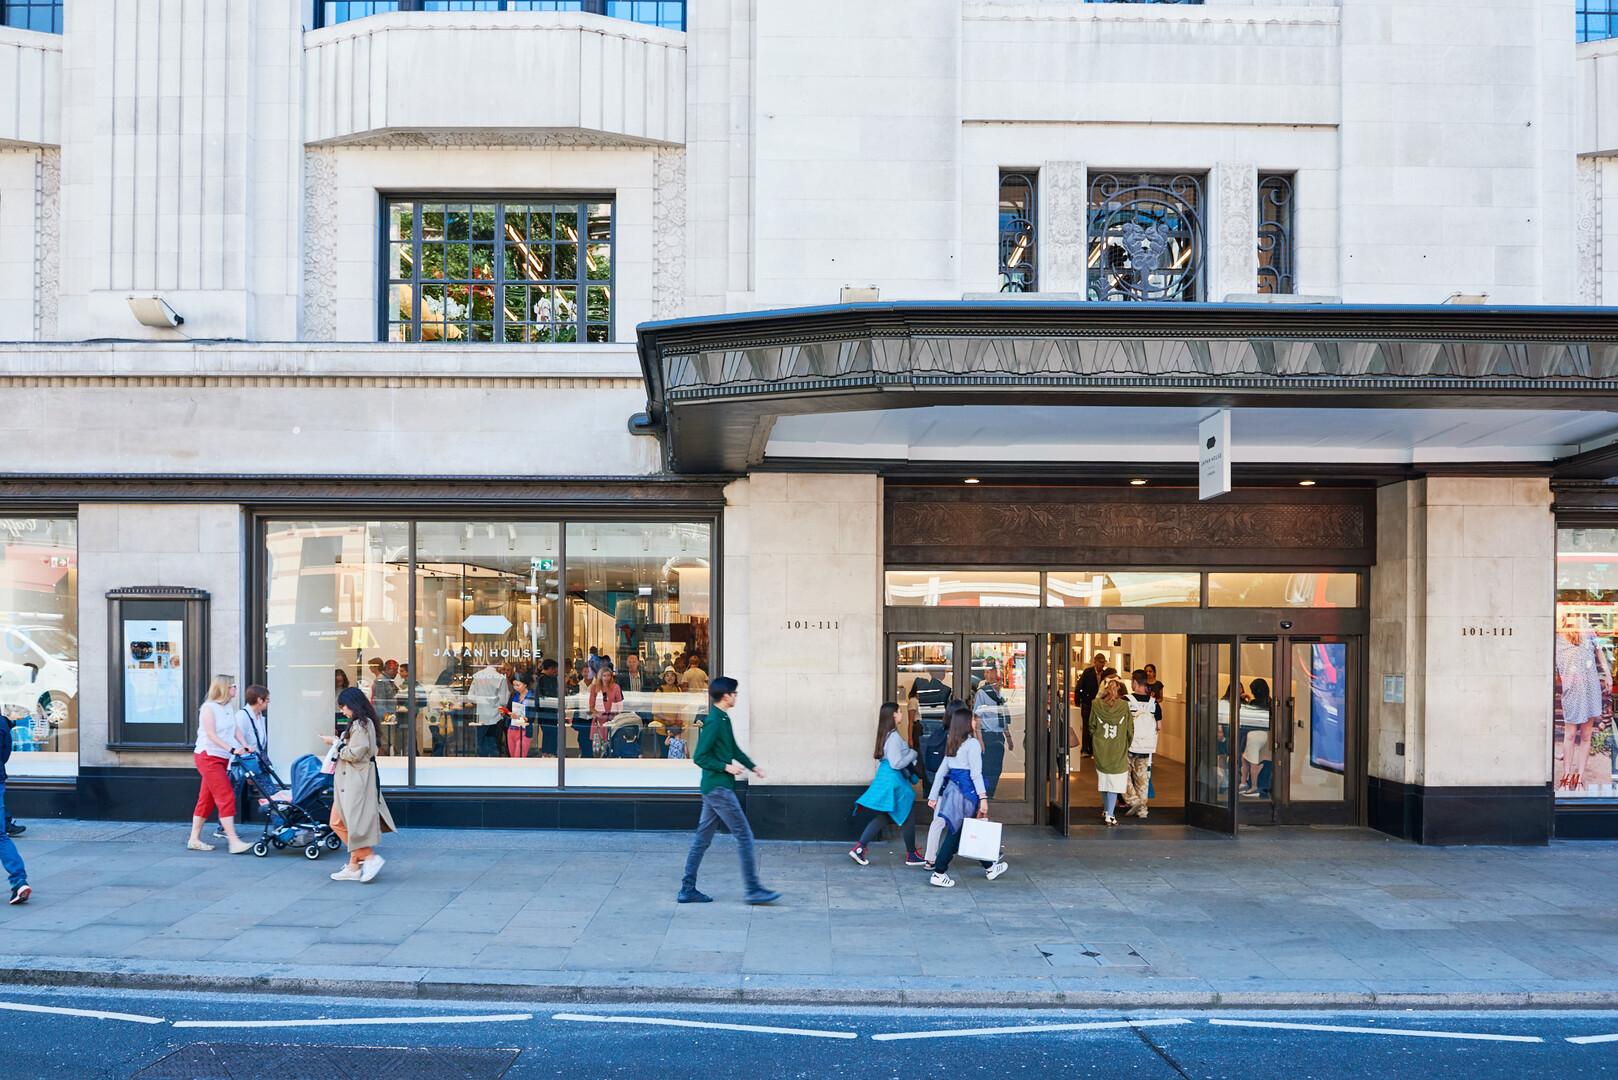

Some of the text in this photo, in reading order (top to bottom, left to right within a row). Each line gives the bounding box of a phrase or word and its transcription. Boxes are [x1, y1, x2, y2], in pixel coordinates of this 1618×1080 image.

[787, 621, 838, 629] 101-111
[1462, 628, 1512, 636] 101-111
[433, 648, 541, 657] JAPAN HOUSE
